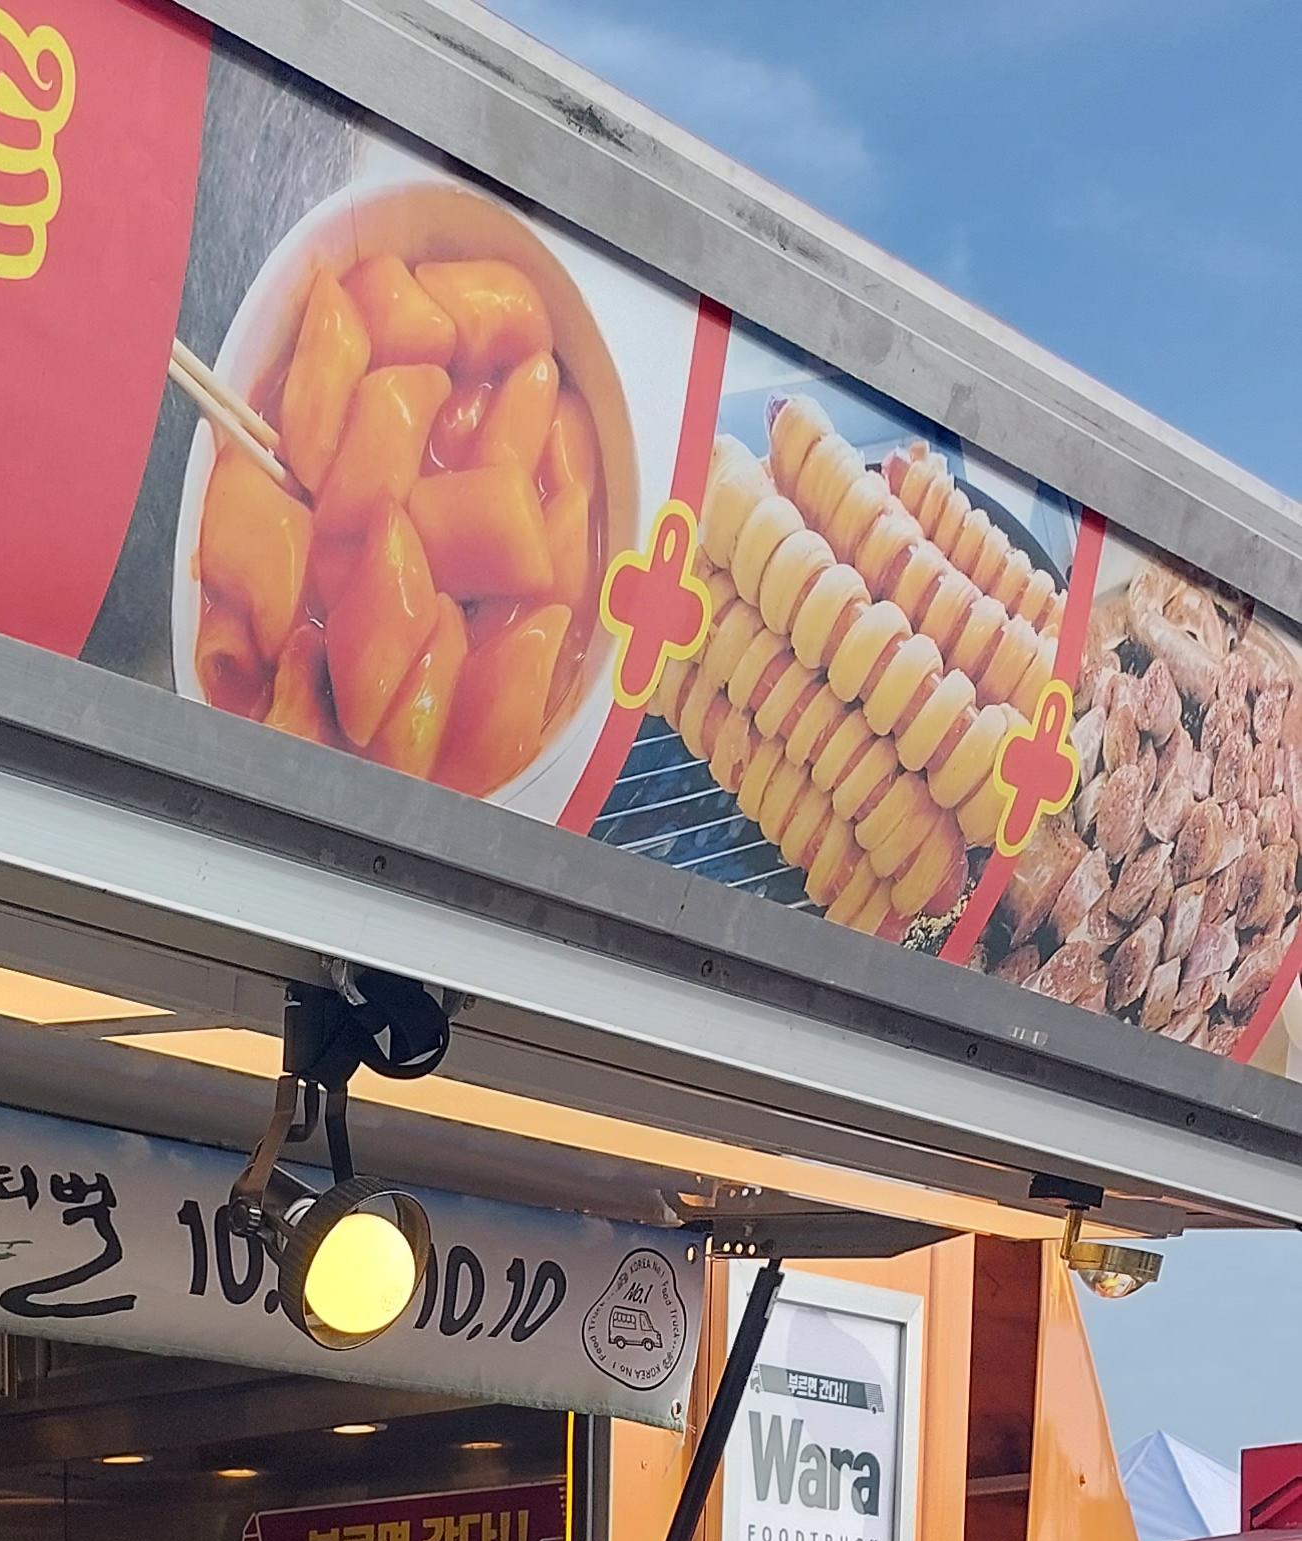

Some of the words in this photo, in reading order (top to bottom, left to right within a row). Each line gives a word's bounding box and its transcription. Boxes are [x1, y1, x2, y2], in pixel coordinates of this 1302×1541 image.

[623, 1282, 654, 1304] No.1
[629, 1258, 651, 1274] KOREA
[661, 1280, 672, 1307] Food
[589, 1335, 607, 1362] Food
[786, 1372, 818, 1399] 부르면
[818, 1378, 848, 1405] 간다!!
[748, 1410, 882, 1518] Wara
